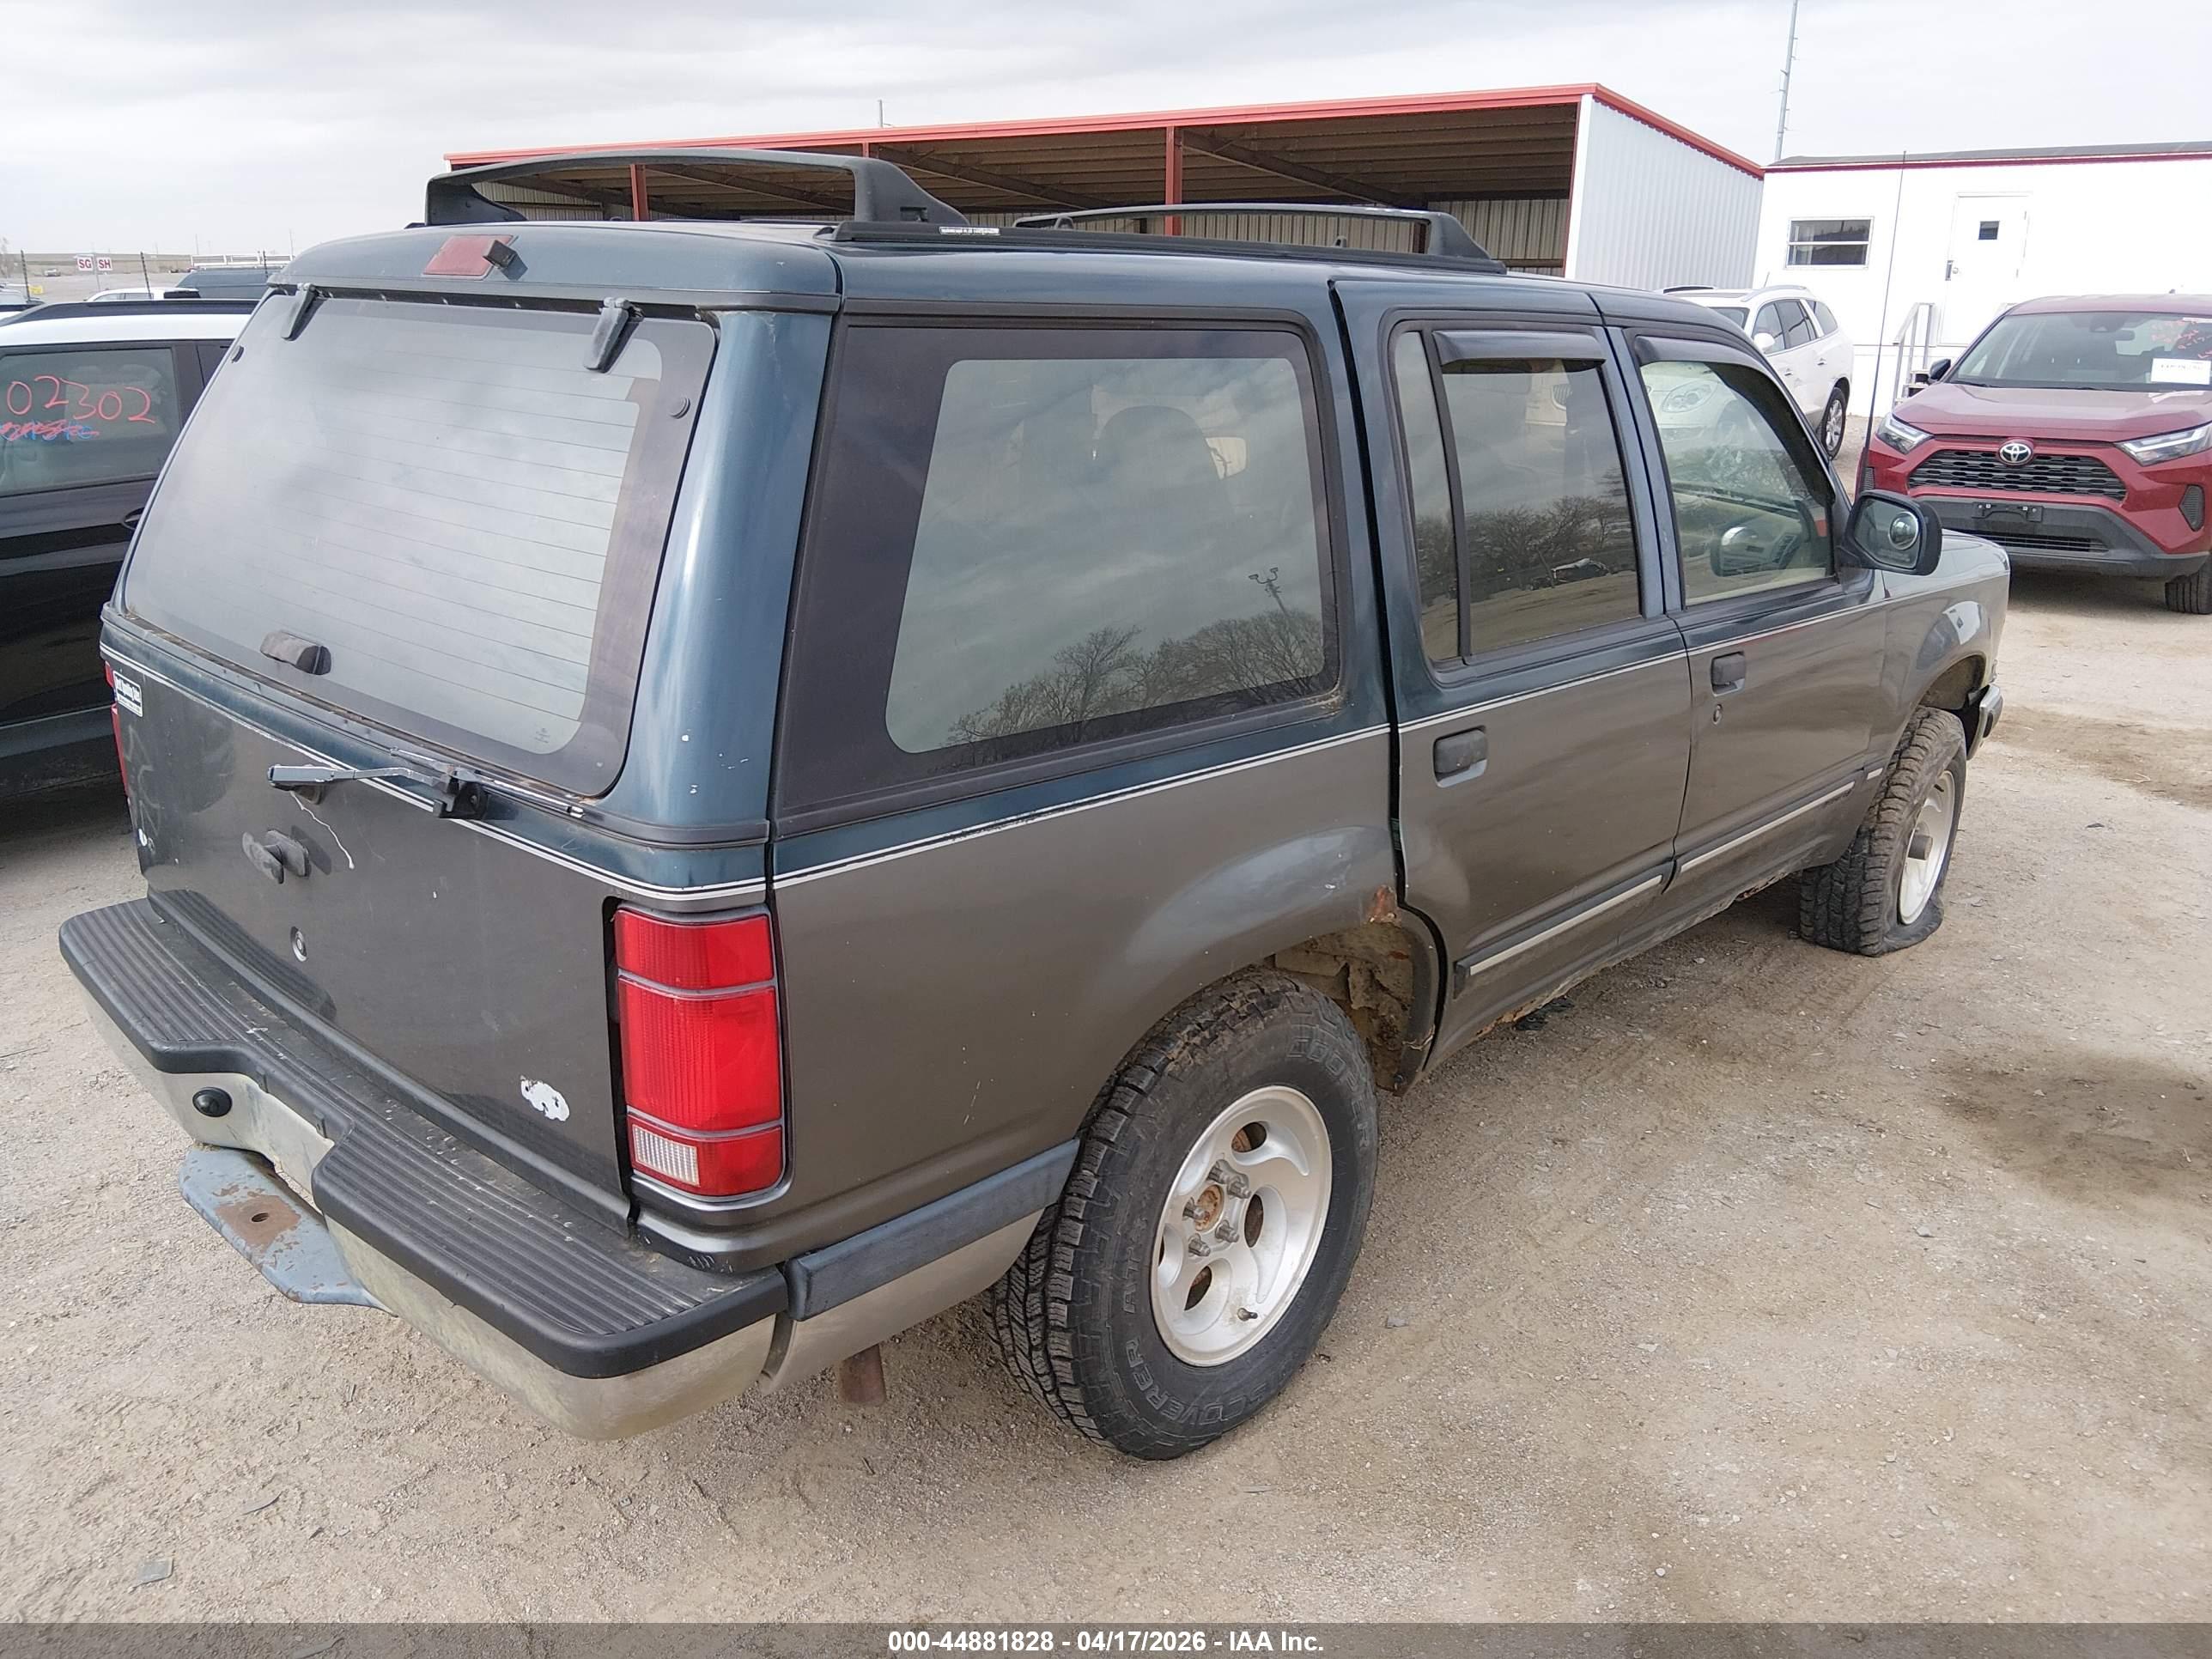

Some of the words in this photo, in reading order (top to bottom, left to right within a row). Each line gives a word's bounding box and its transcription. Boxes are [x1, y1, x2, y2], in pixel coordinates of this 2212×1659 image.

[78, 258, 92, 269] SG
[98, 258, 112, 269] SH
[7, 375, 155, 424] 02302
